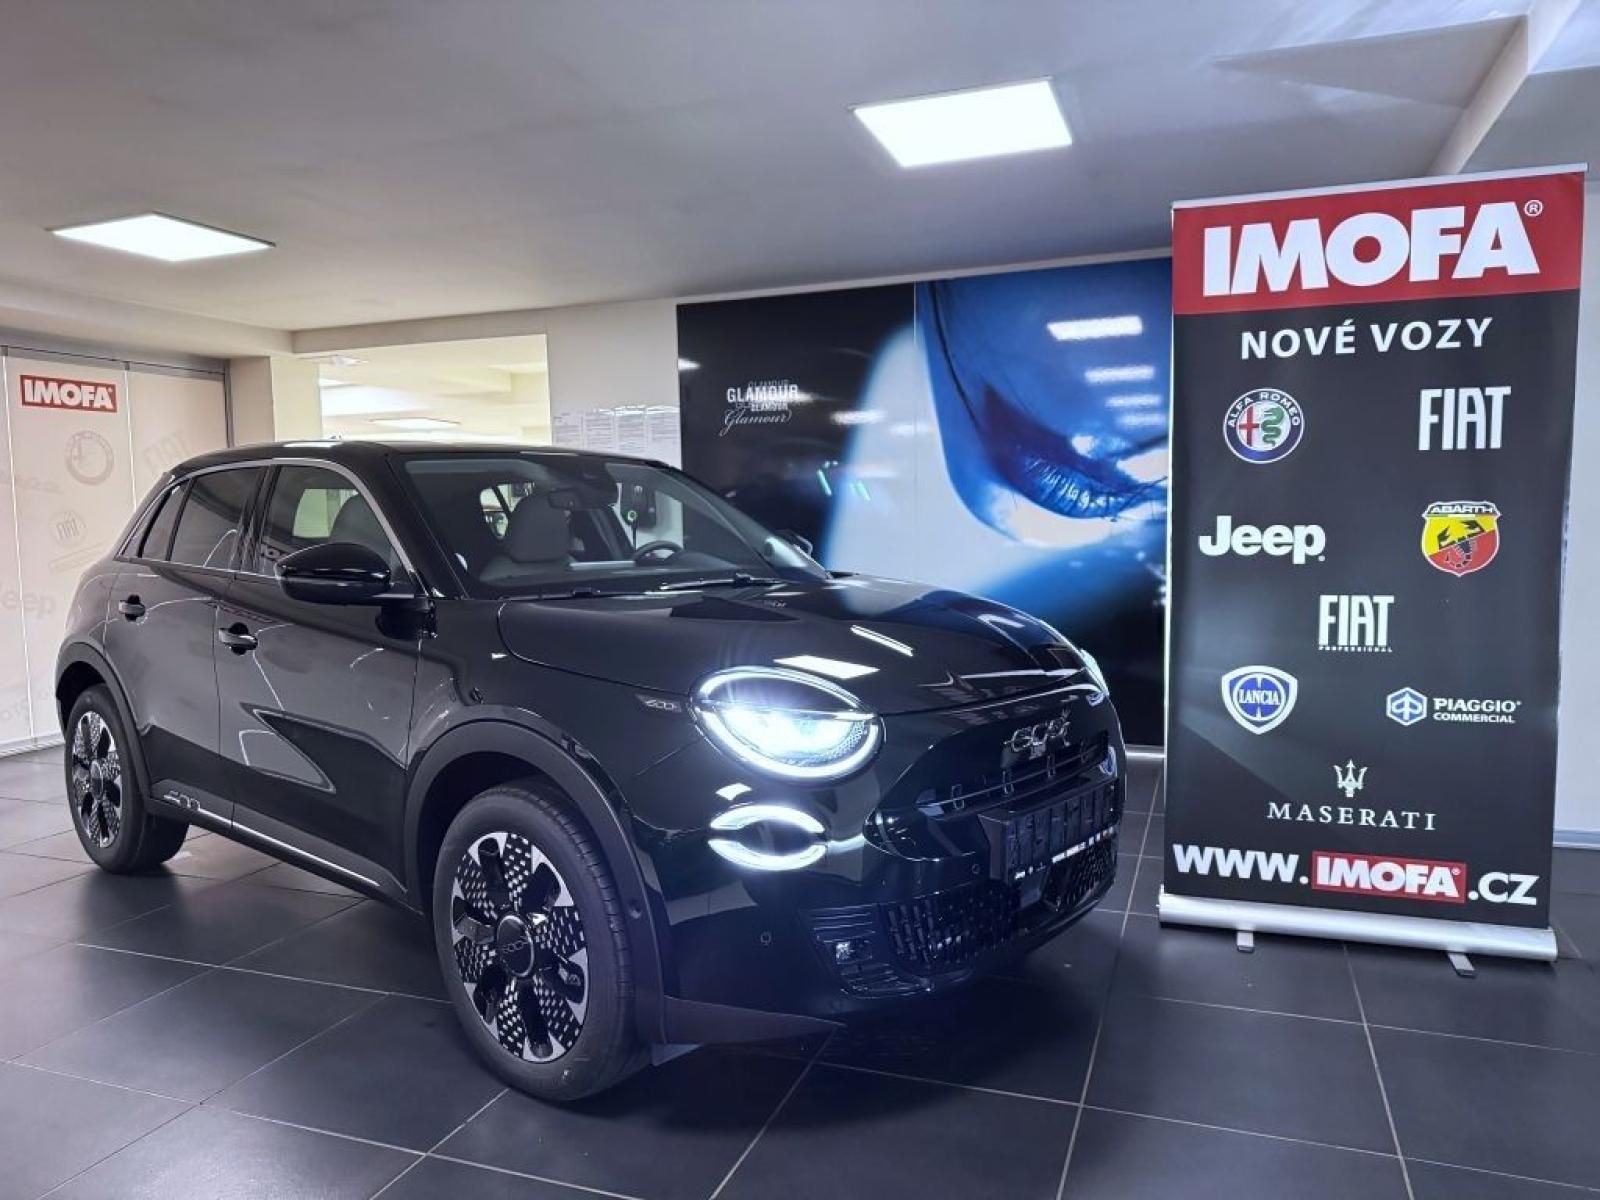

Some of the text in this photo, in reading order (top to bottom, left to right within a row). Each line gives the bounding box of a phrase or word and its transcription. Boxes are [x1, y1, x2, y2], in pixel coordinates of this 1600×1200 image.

[1241, 316, 1493, 361] NOVÉ VOZY
[727, 383, 799, 403] GLAMOUR
[1227, 391, 1301, 428] ALFA ROMEO
[1418, 385, 1512, 451] FIAT
[1430, 504, 1494, 514] ABARTH
[1198, 515, 1325, 565] Jeep
[1318, 594, 1395, 646] FIAT
[1239, 688, 1281, 706] LANCIA
[1432, 711, 1516, 724] COMMERCIAL
[1266, 801, 1439, 831] MASERATI
